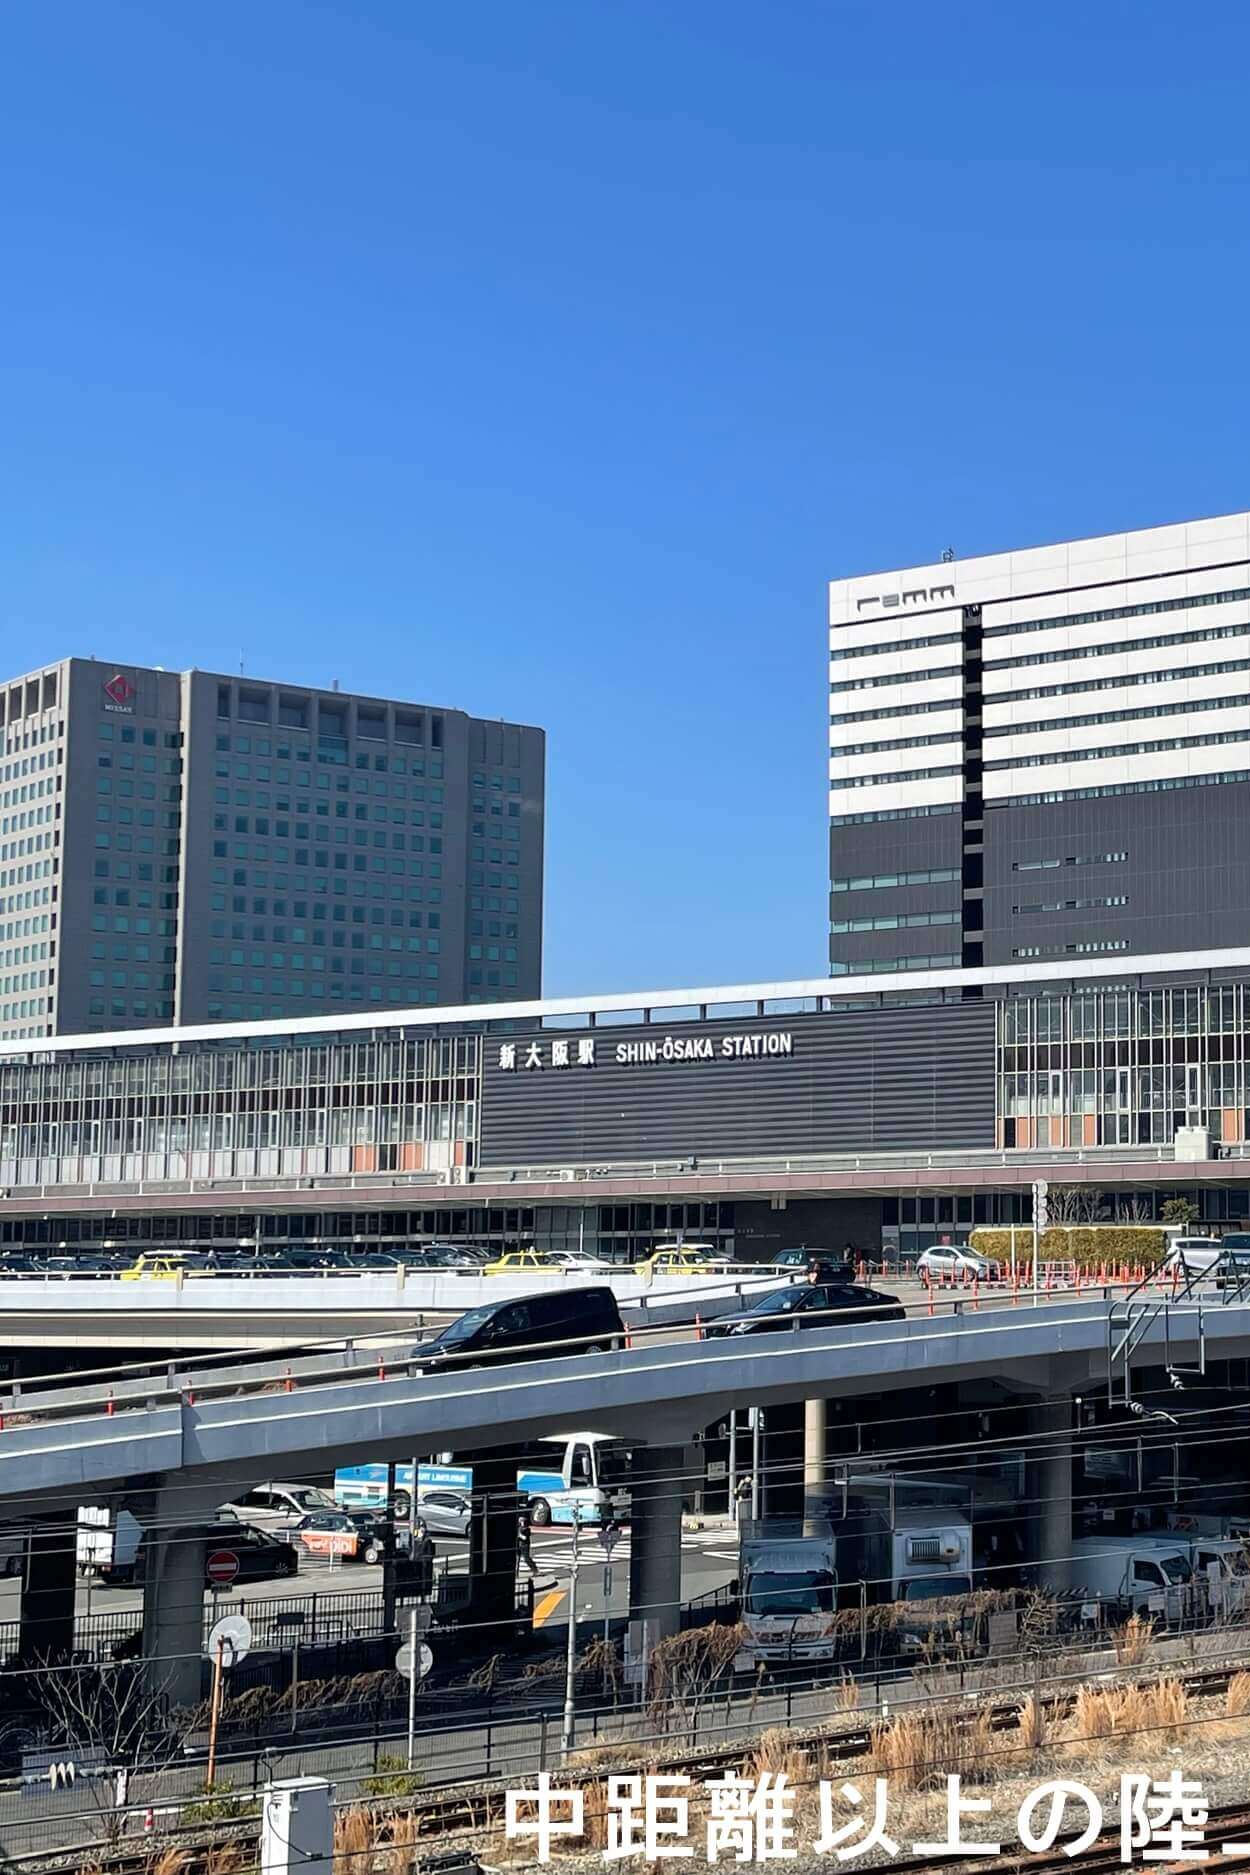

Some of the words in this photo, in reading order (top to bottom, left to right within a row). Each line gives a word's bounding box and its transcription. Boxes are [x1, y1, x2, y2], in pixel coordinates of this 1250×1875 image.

[498, 1039, 596, 1070] 新大阪駅
[615, 1036, 714, 1063] SHIN-ŌSAKA
[721, 1033, 792, 1056] STATION
